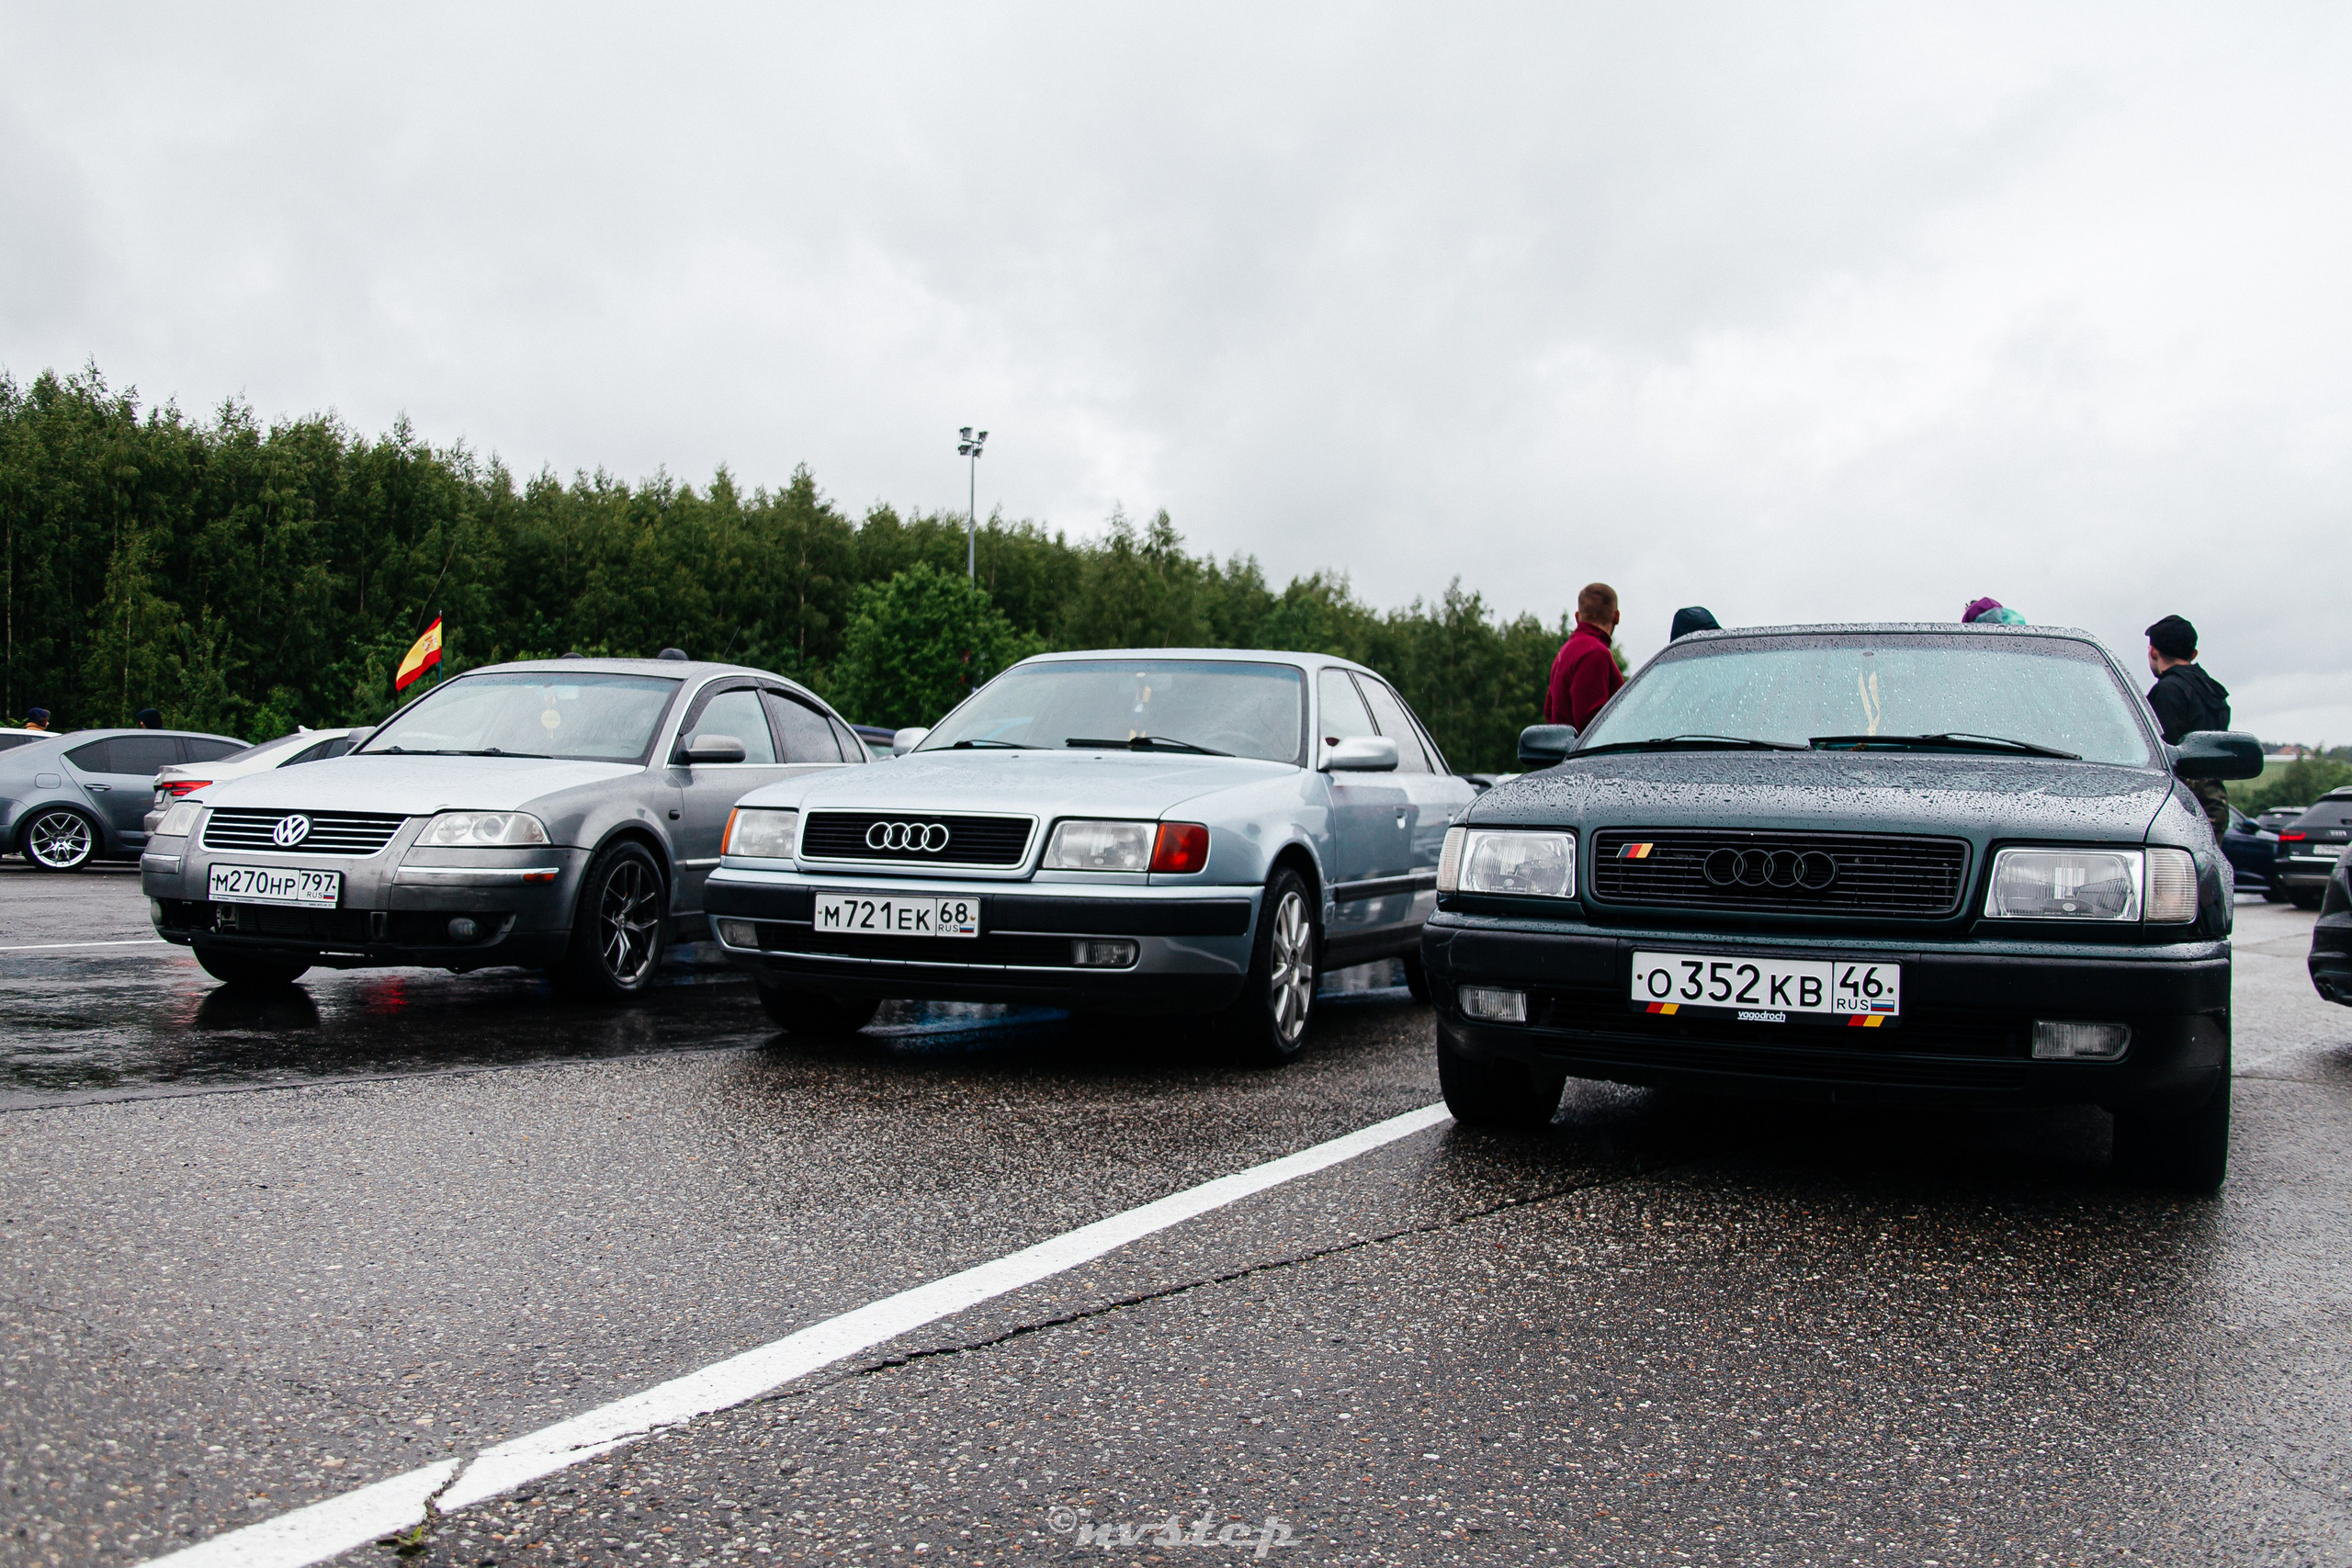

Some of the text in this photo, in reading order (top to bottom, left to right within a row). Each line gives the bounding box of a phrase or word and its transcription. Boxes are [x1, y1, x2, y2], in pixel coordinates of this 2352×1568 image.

[215, 870, 334, 896] М270НР 797
[306, 891, 323, 899] RUS
[824, 899, 968, 931] М721ЕК 68
[938, 924, 959, 933] RUS
[1646, 960, 1884, 1008] О352КВ 46
[1837, 998, 1870, 1011] RUS
[1737, 1010, 1786, 1022] vagodroch
